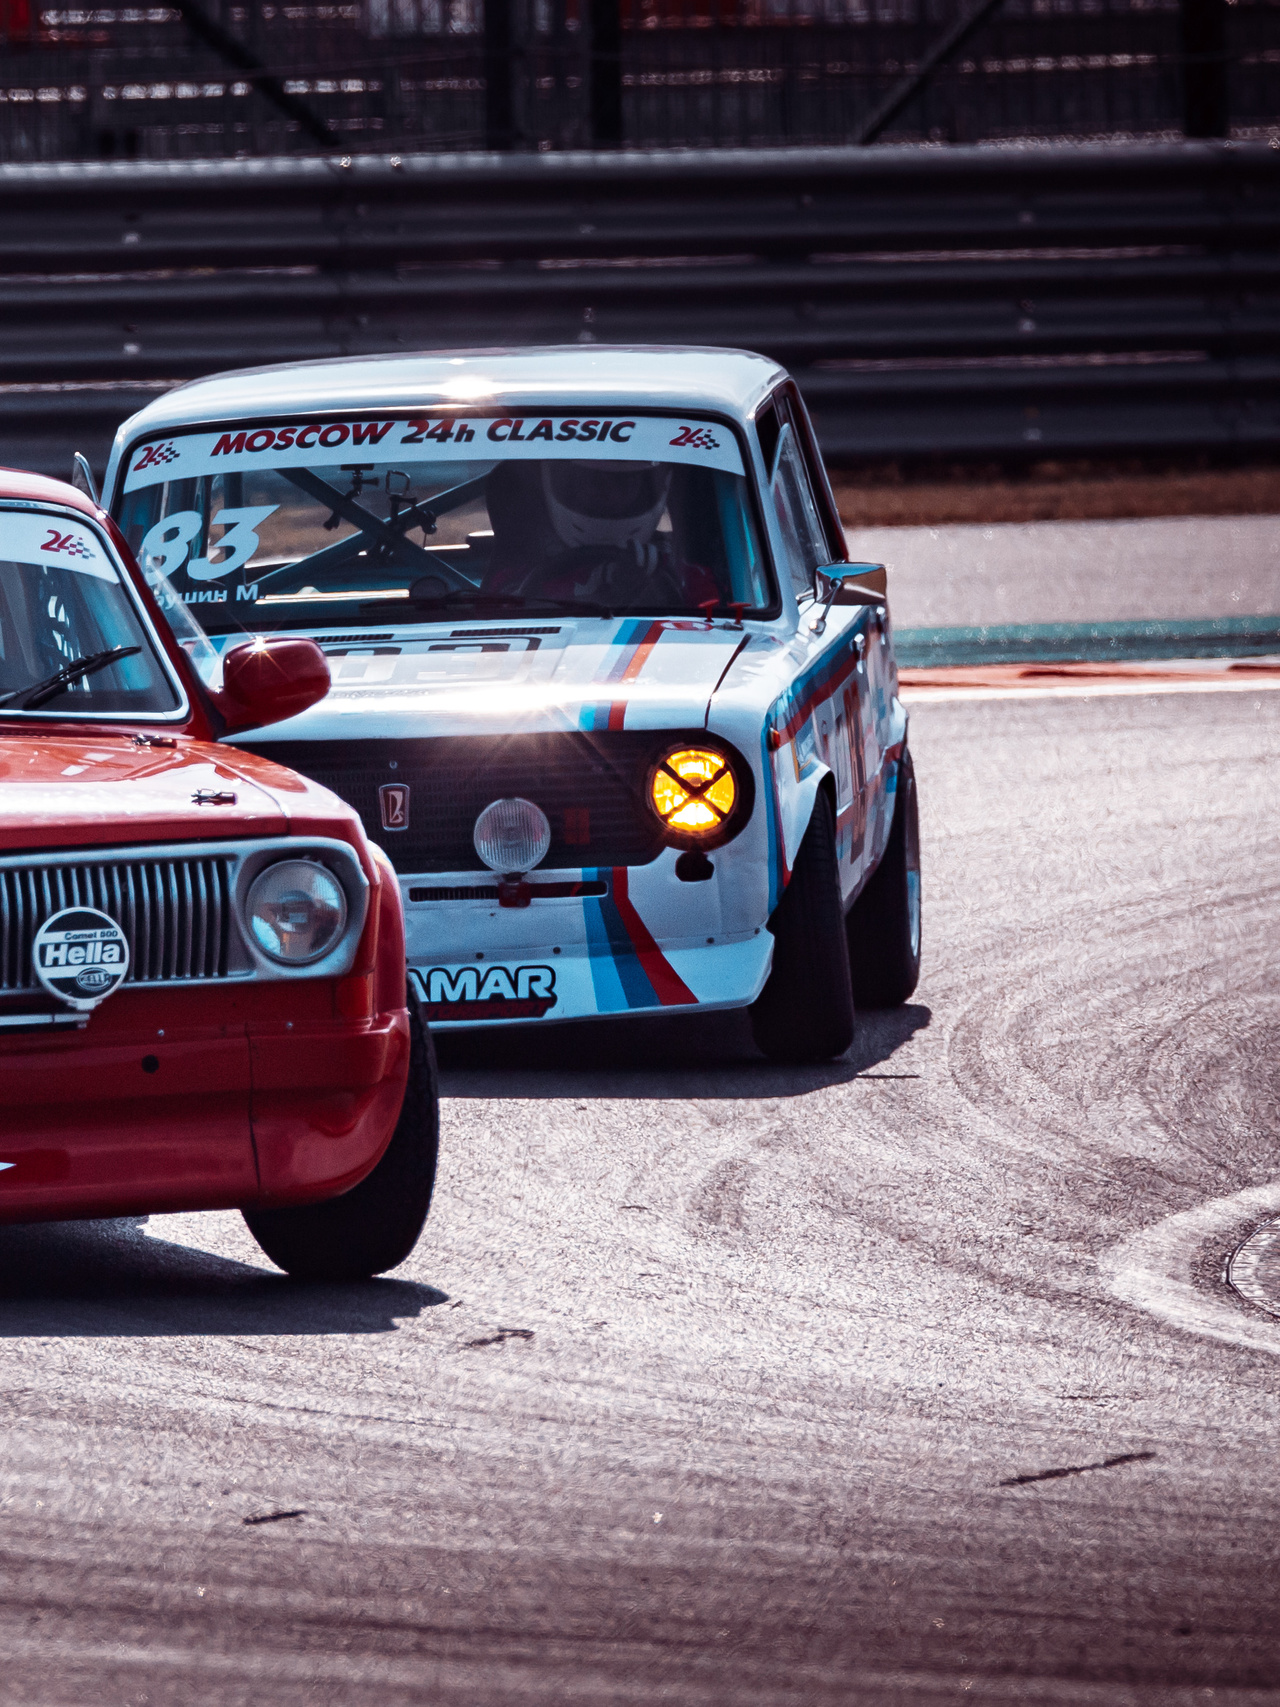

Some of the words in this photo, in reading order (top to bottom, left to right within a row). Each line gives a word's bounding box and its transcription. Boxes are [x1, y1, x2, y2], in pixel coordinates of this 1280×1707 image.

[209, 421, 395, 457] MOSCOW
[400, 419, 476, 445] 24h
[486, 418, 638, 443] CLASSIC
[142, 504, 281, 586] 83
[44, 941, 121, 967] Hella
